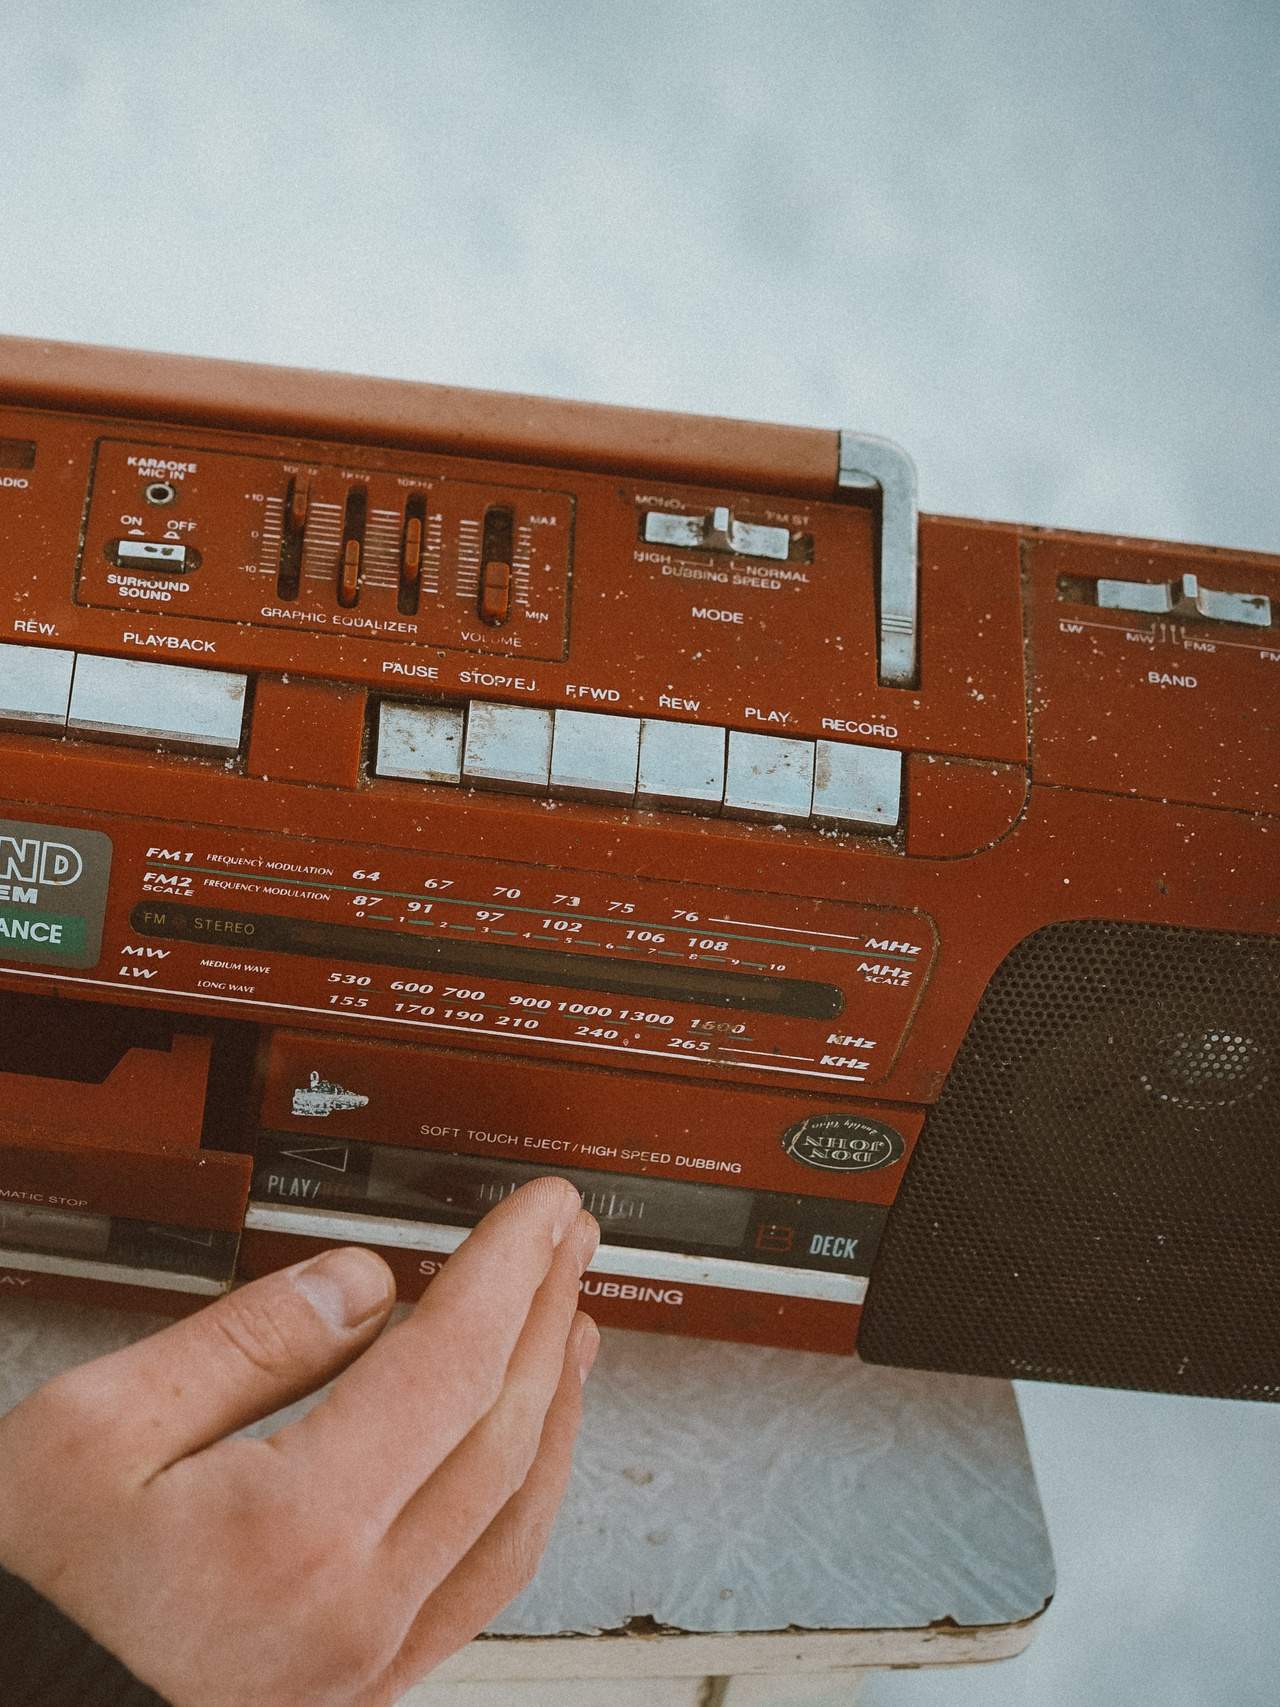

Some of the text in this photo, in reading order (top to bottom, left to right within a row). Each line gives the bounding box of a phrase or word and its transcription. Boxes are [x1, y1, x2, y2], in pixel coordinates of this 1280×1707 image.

[127, 456, 197, 474] KARAOKE
[138, 467, 185, 480] MIC IN
[120, 515, 143, 526] ON
[167, 520, 197, 532] OFF
[634, 551, 671, 563] HIGH
[238, 564, 257, 574] -10
[662, 565, 782, 590] DUBBING SPEED
[746, 566, 810, 583] NORMAL
[107, 574, 190, 592] SURROUND
[119, 587, 171, 601] SOUND
[261, 607, 418, 634] GRAPHIC EQUALIZER
[525, 610, 549, 621] MIN
[692, 606, 744, 624] MODE
[1059, 623, 1083, 634] LW
[123, 632, 216, 653] PLAYBACK
[1126, 632, 1155, 644] MW
[1183, 641, 1216, 653] FM2
[382, 661, 439, 679] PAUSE
[1148, 671, 1198, 688] BAND
[745, 707, 790, 724] PLAY
[822, 718, 898, 738] RECORD
[146, 847, 922, 955] FM1 FREQUENCY MODULATION 64 67 70 73 75 76 MHz
[143, 872, 913, 979] FM2 FREQUENCY MODULATION 87 91 97 102 106 108 MHz
[144, 912, 255, 936] FM STEREO
[142, 884, 195, 897] SCALE
[480, 926, 489, 934] 3
[770, 964, 786, 972] 10
[864, 975, 910, 987] SCALE
[120, 945, 877, 1049] MW MEDIUM WAVE 530 600 700 900 1000 1300 1600 KHz
[119, 966, 870, 1070] LW LONG WAVE 155 170 190 210 240 265 KHz
[420, 1125, 460, 1138] SOFT
[467, 1130, 519, 1145] TOUCH
[620, 1149, 670, 1164] SPEED
[675, 1156, 742, 1173] DUBBING
[803, 1135, 885, 1151] JOHN
[809, 1147, 874, 1162] DON
[49, 1196, 88, 1207] STOP
[810, 1234, 859, 1259] DECK
